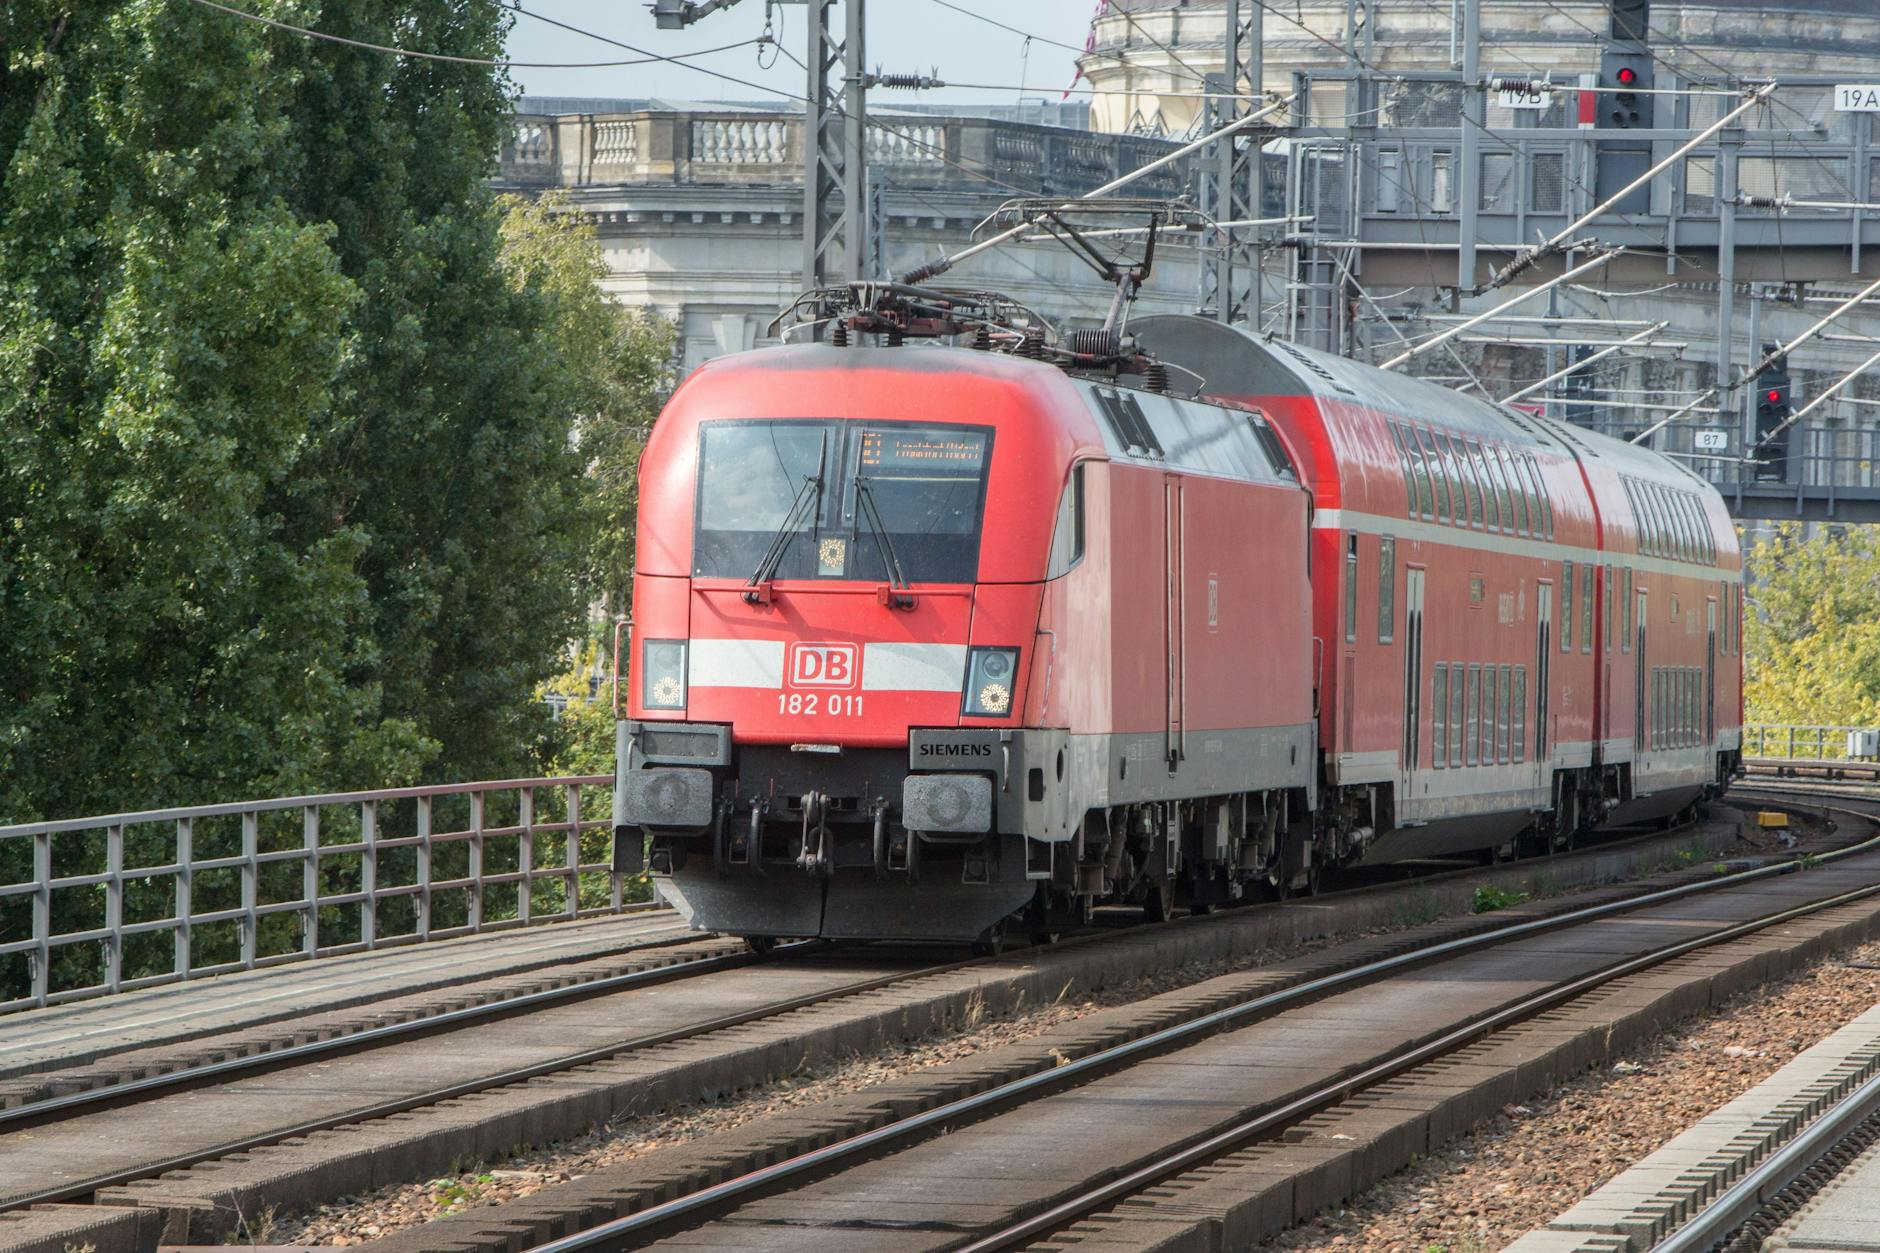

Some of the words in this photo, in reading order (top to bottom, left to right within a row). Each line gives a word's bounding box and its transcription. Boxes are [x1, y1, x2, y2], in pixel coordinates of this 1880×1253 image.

[1842, 90, 1879, 107] 19A
[1704, 434, 1719, 446] 87
[798, 650, 848, 680] DB
[778, 693, 818, 715] 182
[828, 694, 863, 717] 011
[920, 743, 992, 756] SIEMENS
